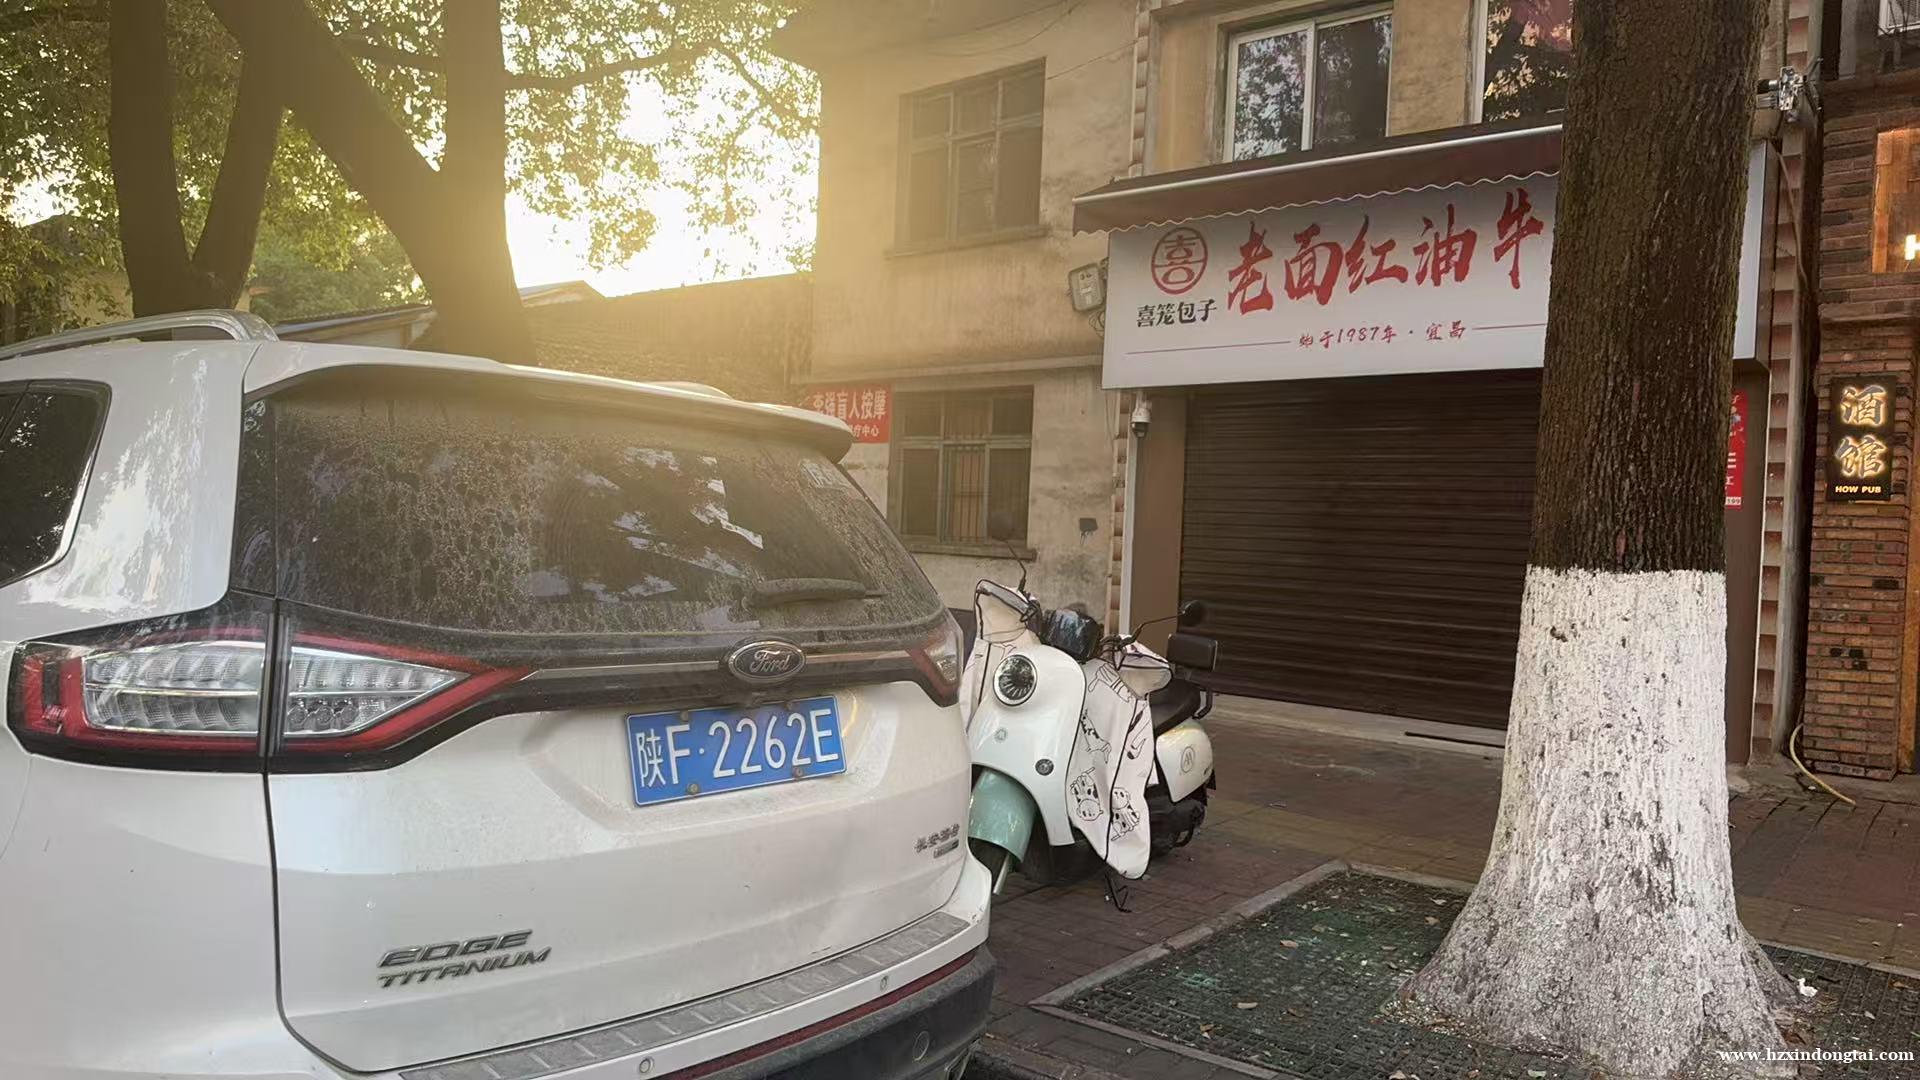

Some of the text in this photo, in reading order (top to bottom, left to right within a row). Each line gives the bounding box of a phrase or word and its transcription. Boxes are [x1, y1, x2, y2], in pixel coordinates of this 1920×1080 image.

[1227, 187, 1544, 315] 老面红油牛
[1136, 298, 1217, 328] 喜笼包子
[848, 424, 879, 437] 疗中心
[1834, 384, 1888, 478] 酒馆
[1835, 485, 1881, 494] HOW PUB
[749, 649, 791, 673] Ford
[377, 929, 533, 967] EDGE
[377, 946, 552, 988] TITANIUM
